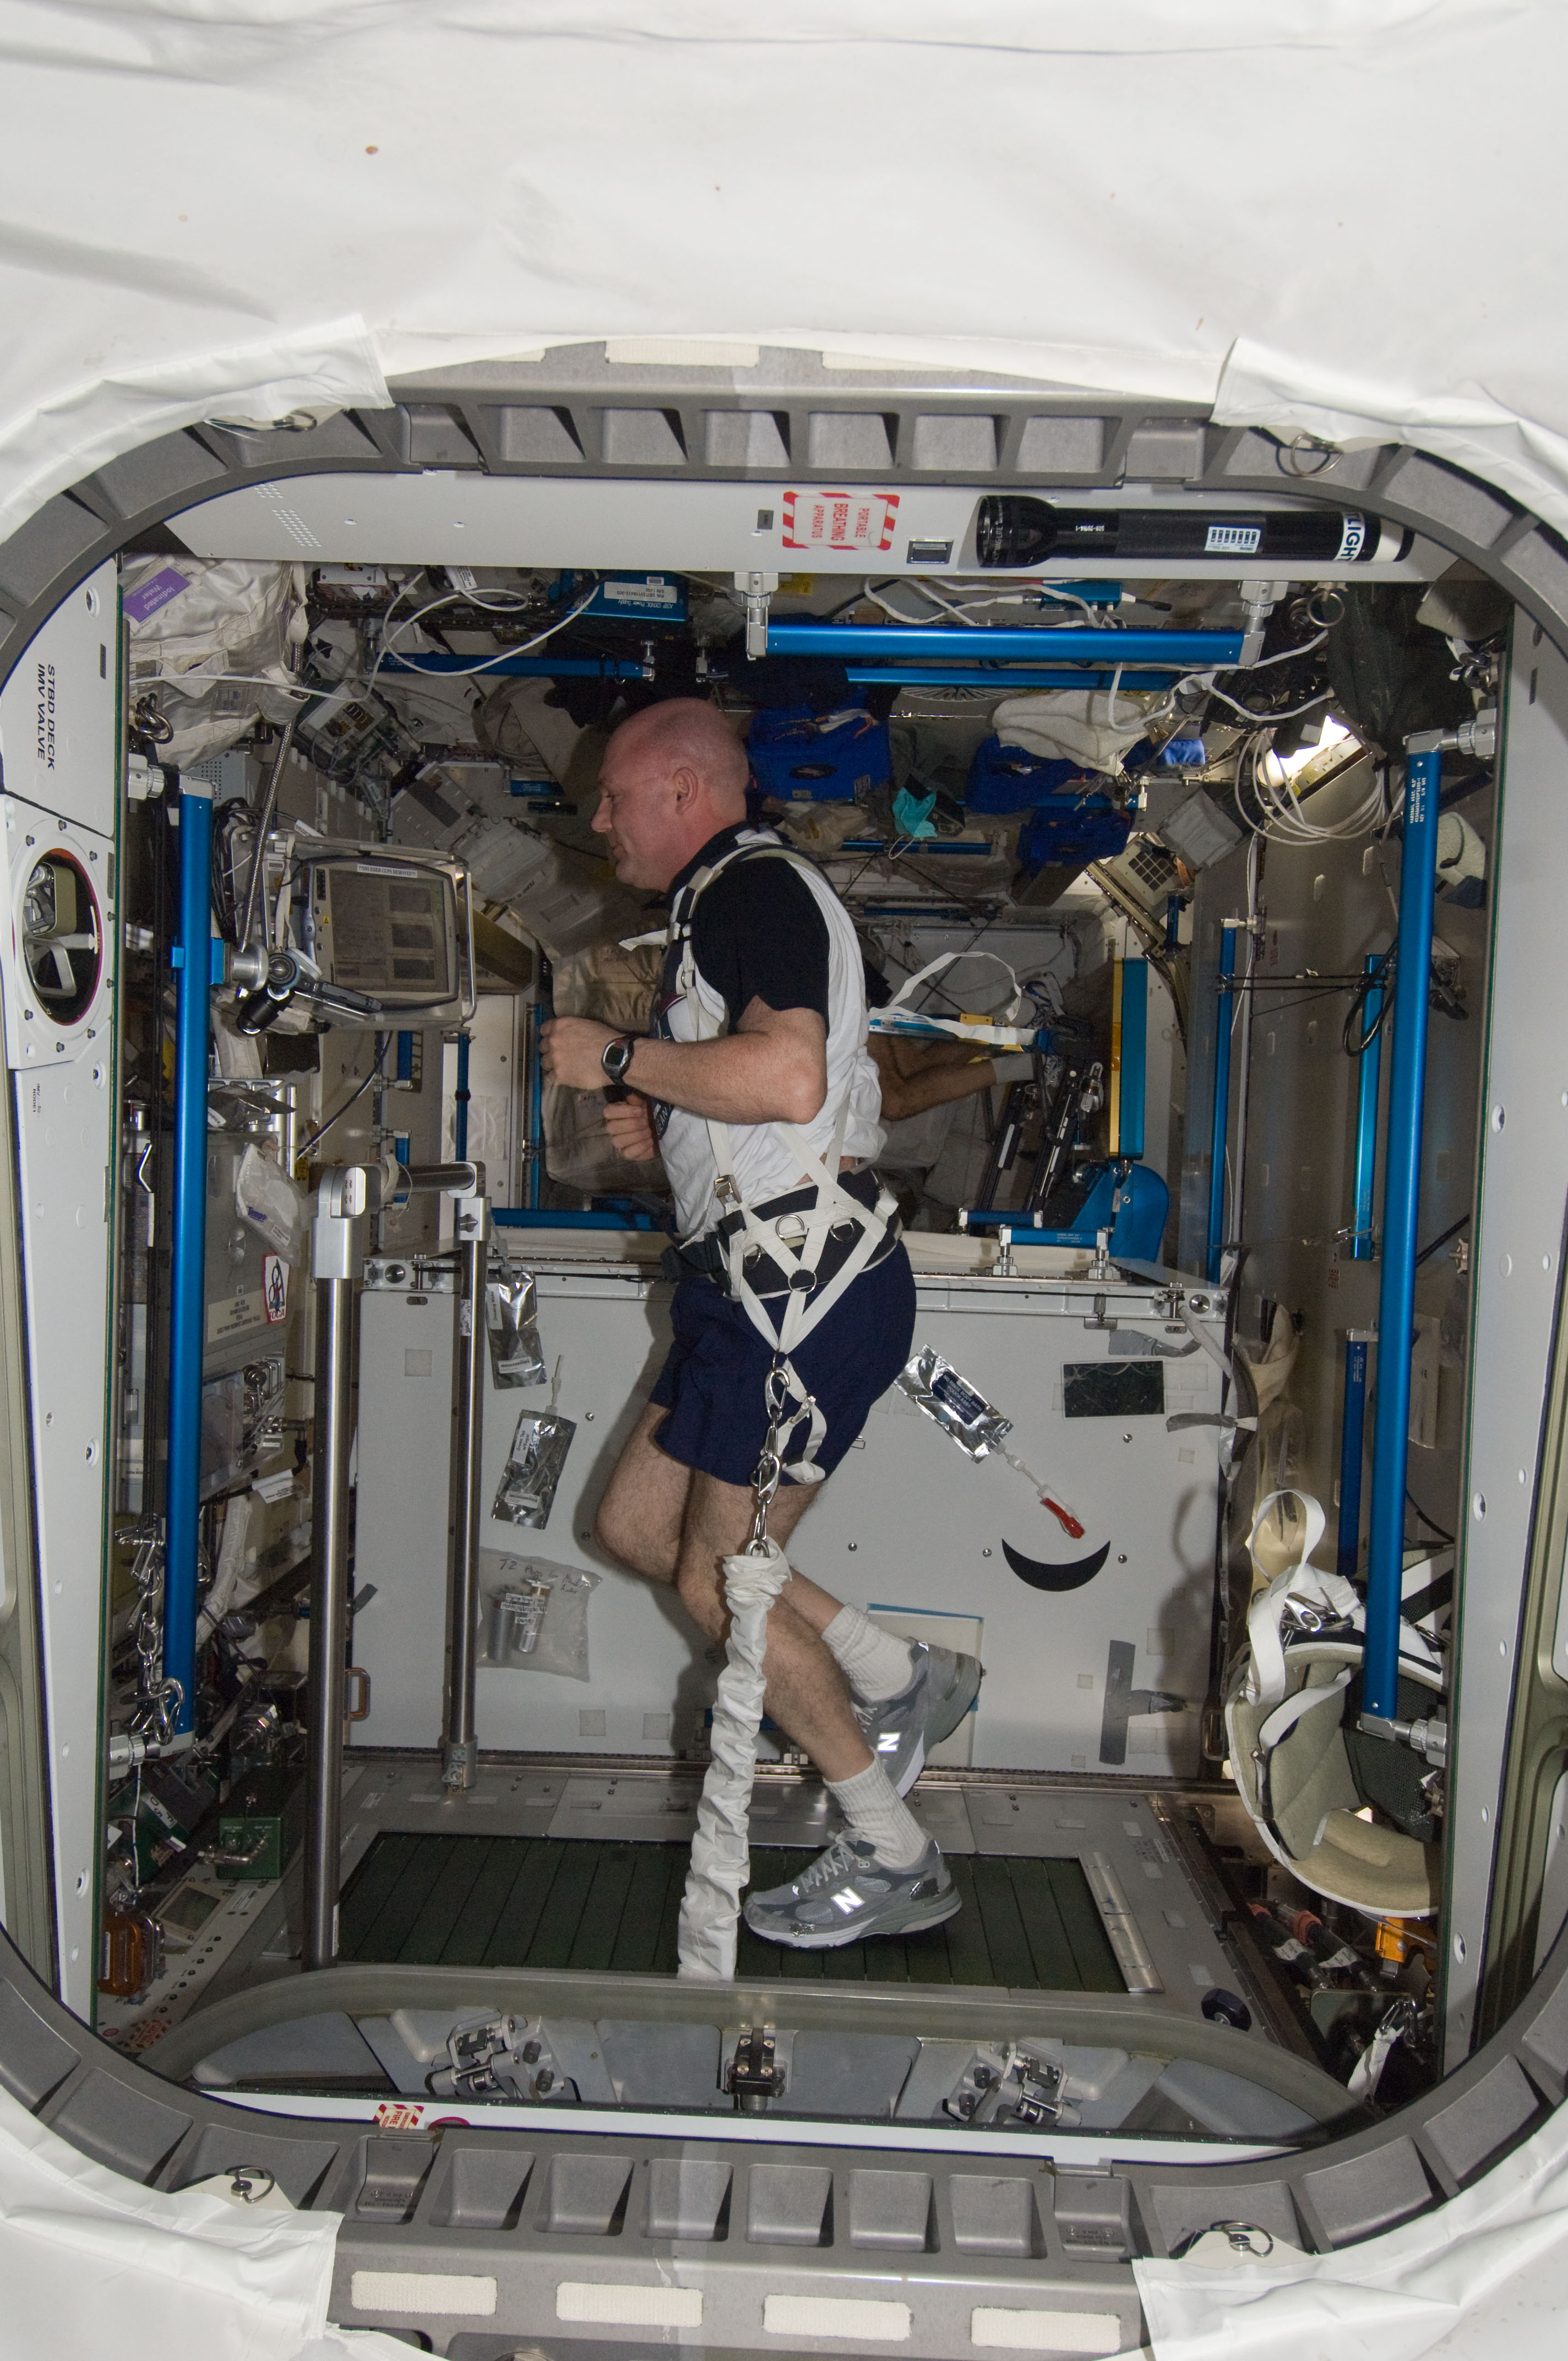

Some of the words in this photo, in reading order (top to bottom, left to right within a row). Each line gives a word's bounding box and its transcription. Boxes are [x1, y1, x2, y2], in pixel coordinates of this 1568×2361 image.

[812, 504, 824, 538] APPARATUS
[830, 503, 848, 541] BREATHING
[855, 508, 869, 538] PORTABLE
[141, 585, 162, 600] Water
[144, 586, 175, 611] Iodinated
[247, 1206, 268, 1220] Tempo
[269, 1308, 285, 1319] TOCA
[947, 1386, 961, 1399] POUCH
[960, 1397, 972, 1407] ASSY
[949, 1380, 961, 1392] RINSE
[960, 1391, 972, 1401] BODY
[971, 1401, 982, 1411] BATH
[500, 1559, 516, 1570] T2
[877, 1732, 901, 1753] N
[831, 1886, 865, 1915] N
[389, 2111, 402, 2125] FIRE
